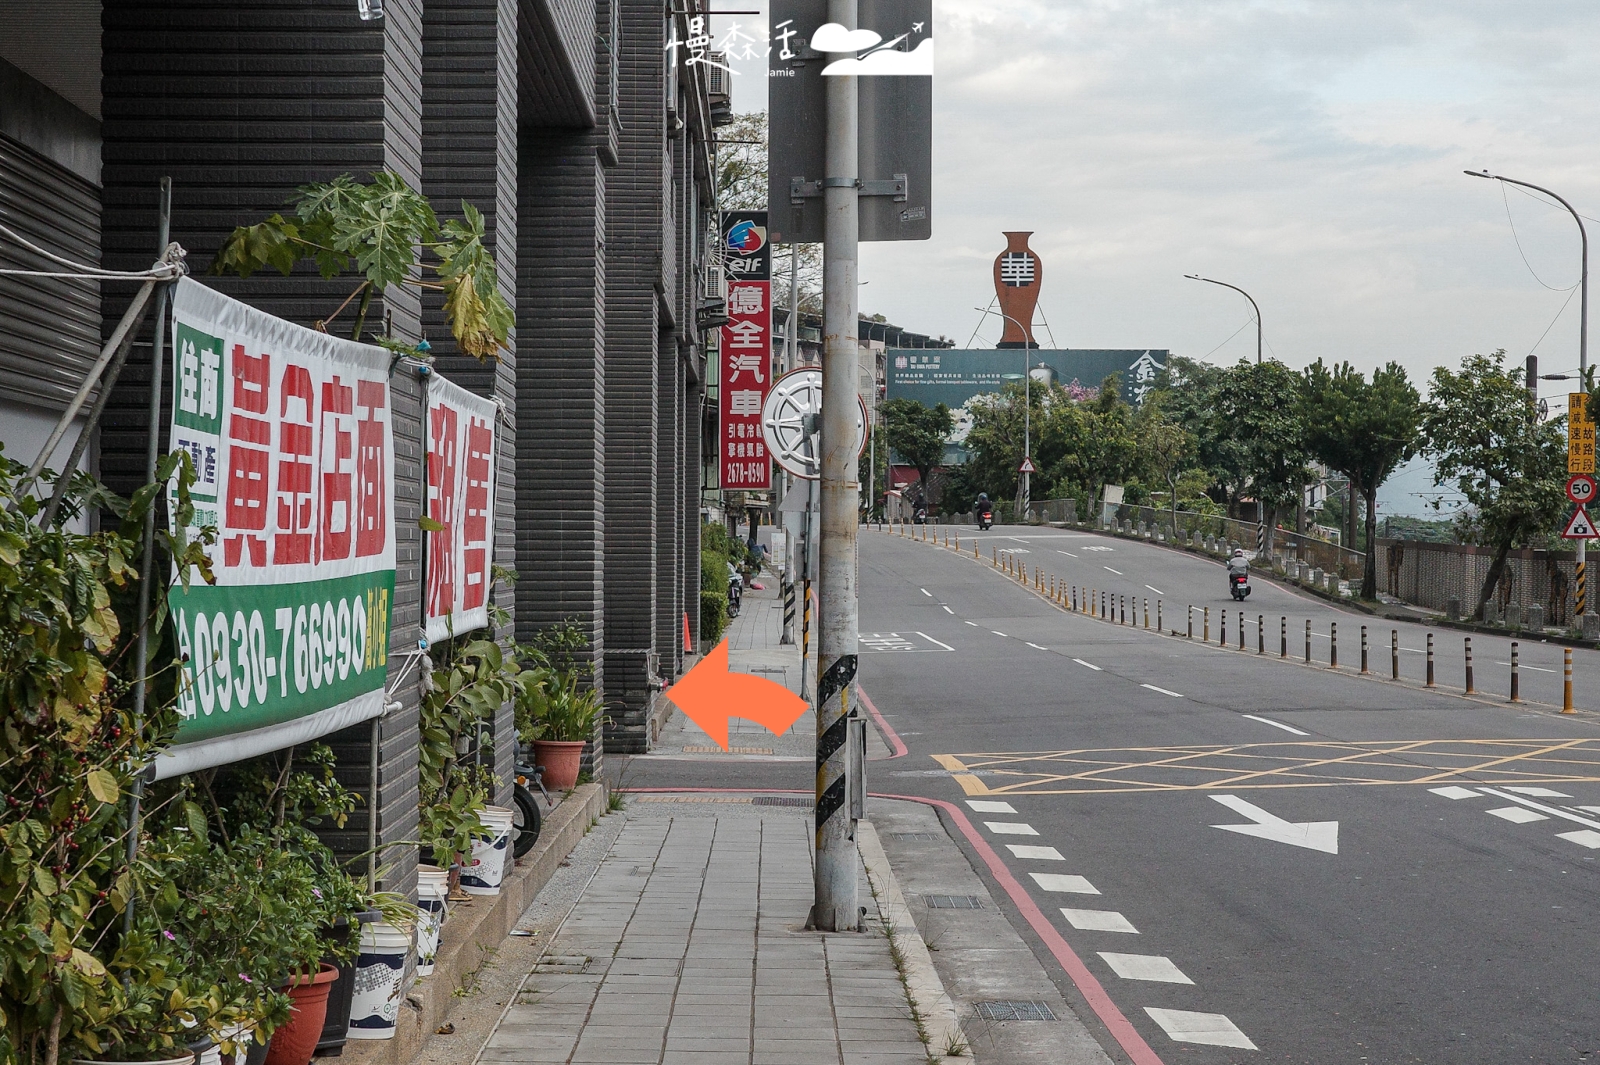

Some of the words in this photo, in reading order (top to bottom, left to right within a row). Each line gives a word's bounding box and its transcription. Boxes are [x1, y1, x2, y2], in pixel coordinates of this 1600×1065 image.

[729, 257, 763, 273] elf
[179, 338, 220, 420] 住商
[729, 285, 765, 417] 億全汽車
[223, 344, 386, 568] 黃金店面
[1570, 395, 1582, 472] 請減速慢行
[1572, 484, 1591, 494] 50
